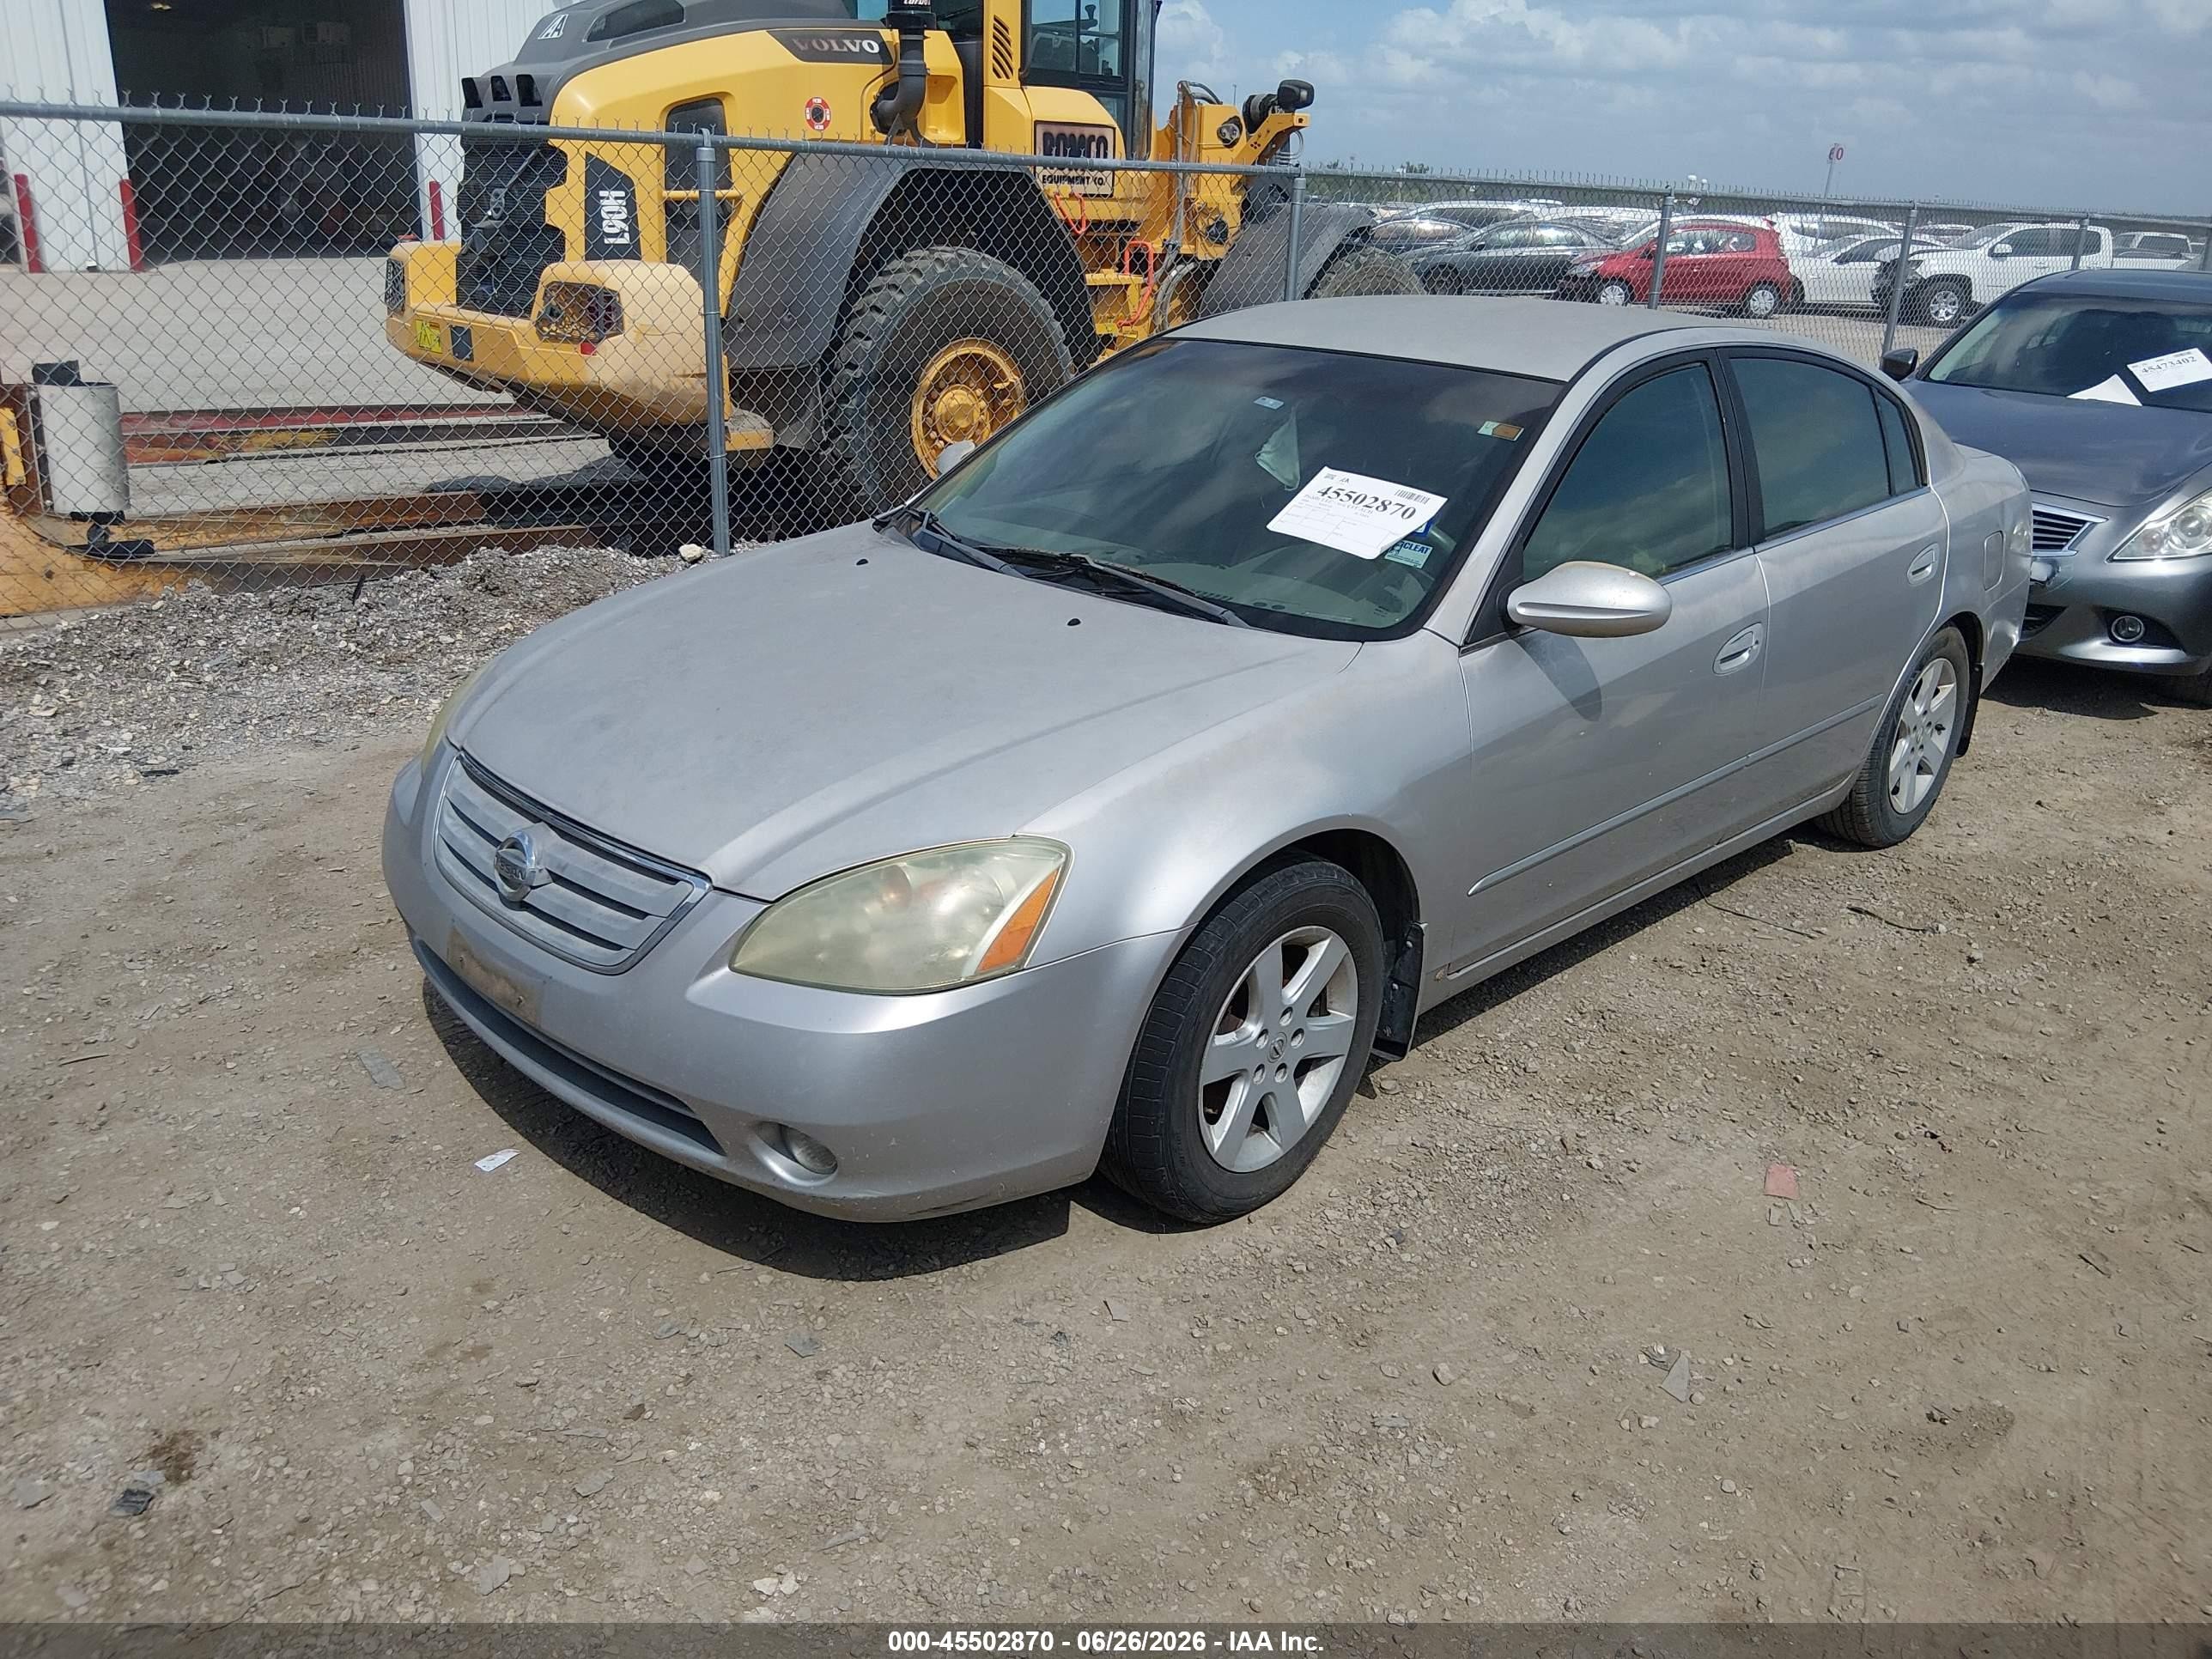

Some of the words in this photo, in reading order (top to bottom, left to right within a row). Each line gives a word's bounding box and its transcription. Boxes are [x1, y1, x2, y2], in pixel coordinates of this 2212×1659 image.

[792, 38, 880, 54] VOLVO
[1042, 174, 1091, 186] EQUIPMENT
[599, 190, 631, 245] L90H
[1317, 486, 1416, 520] 45502870
